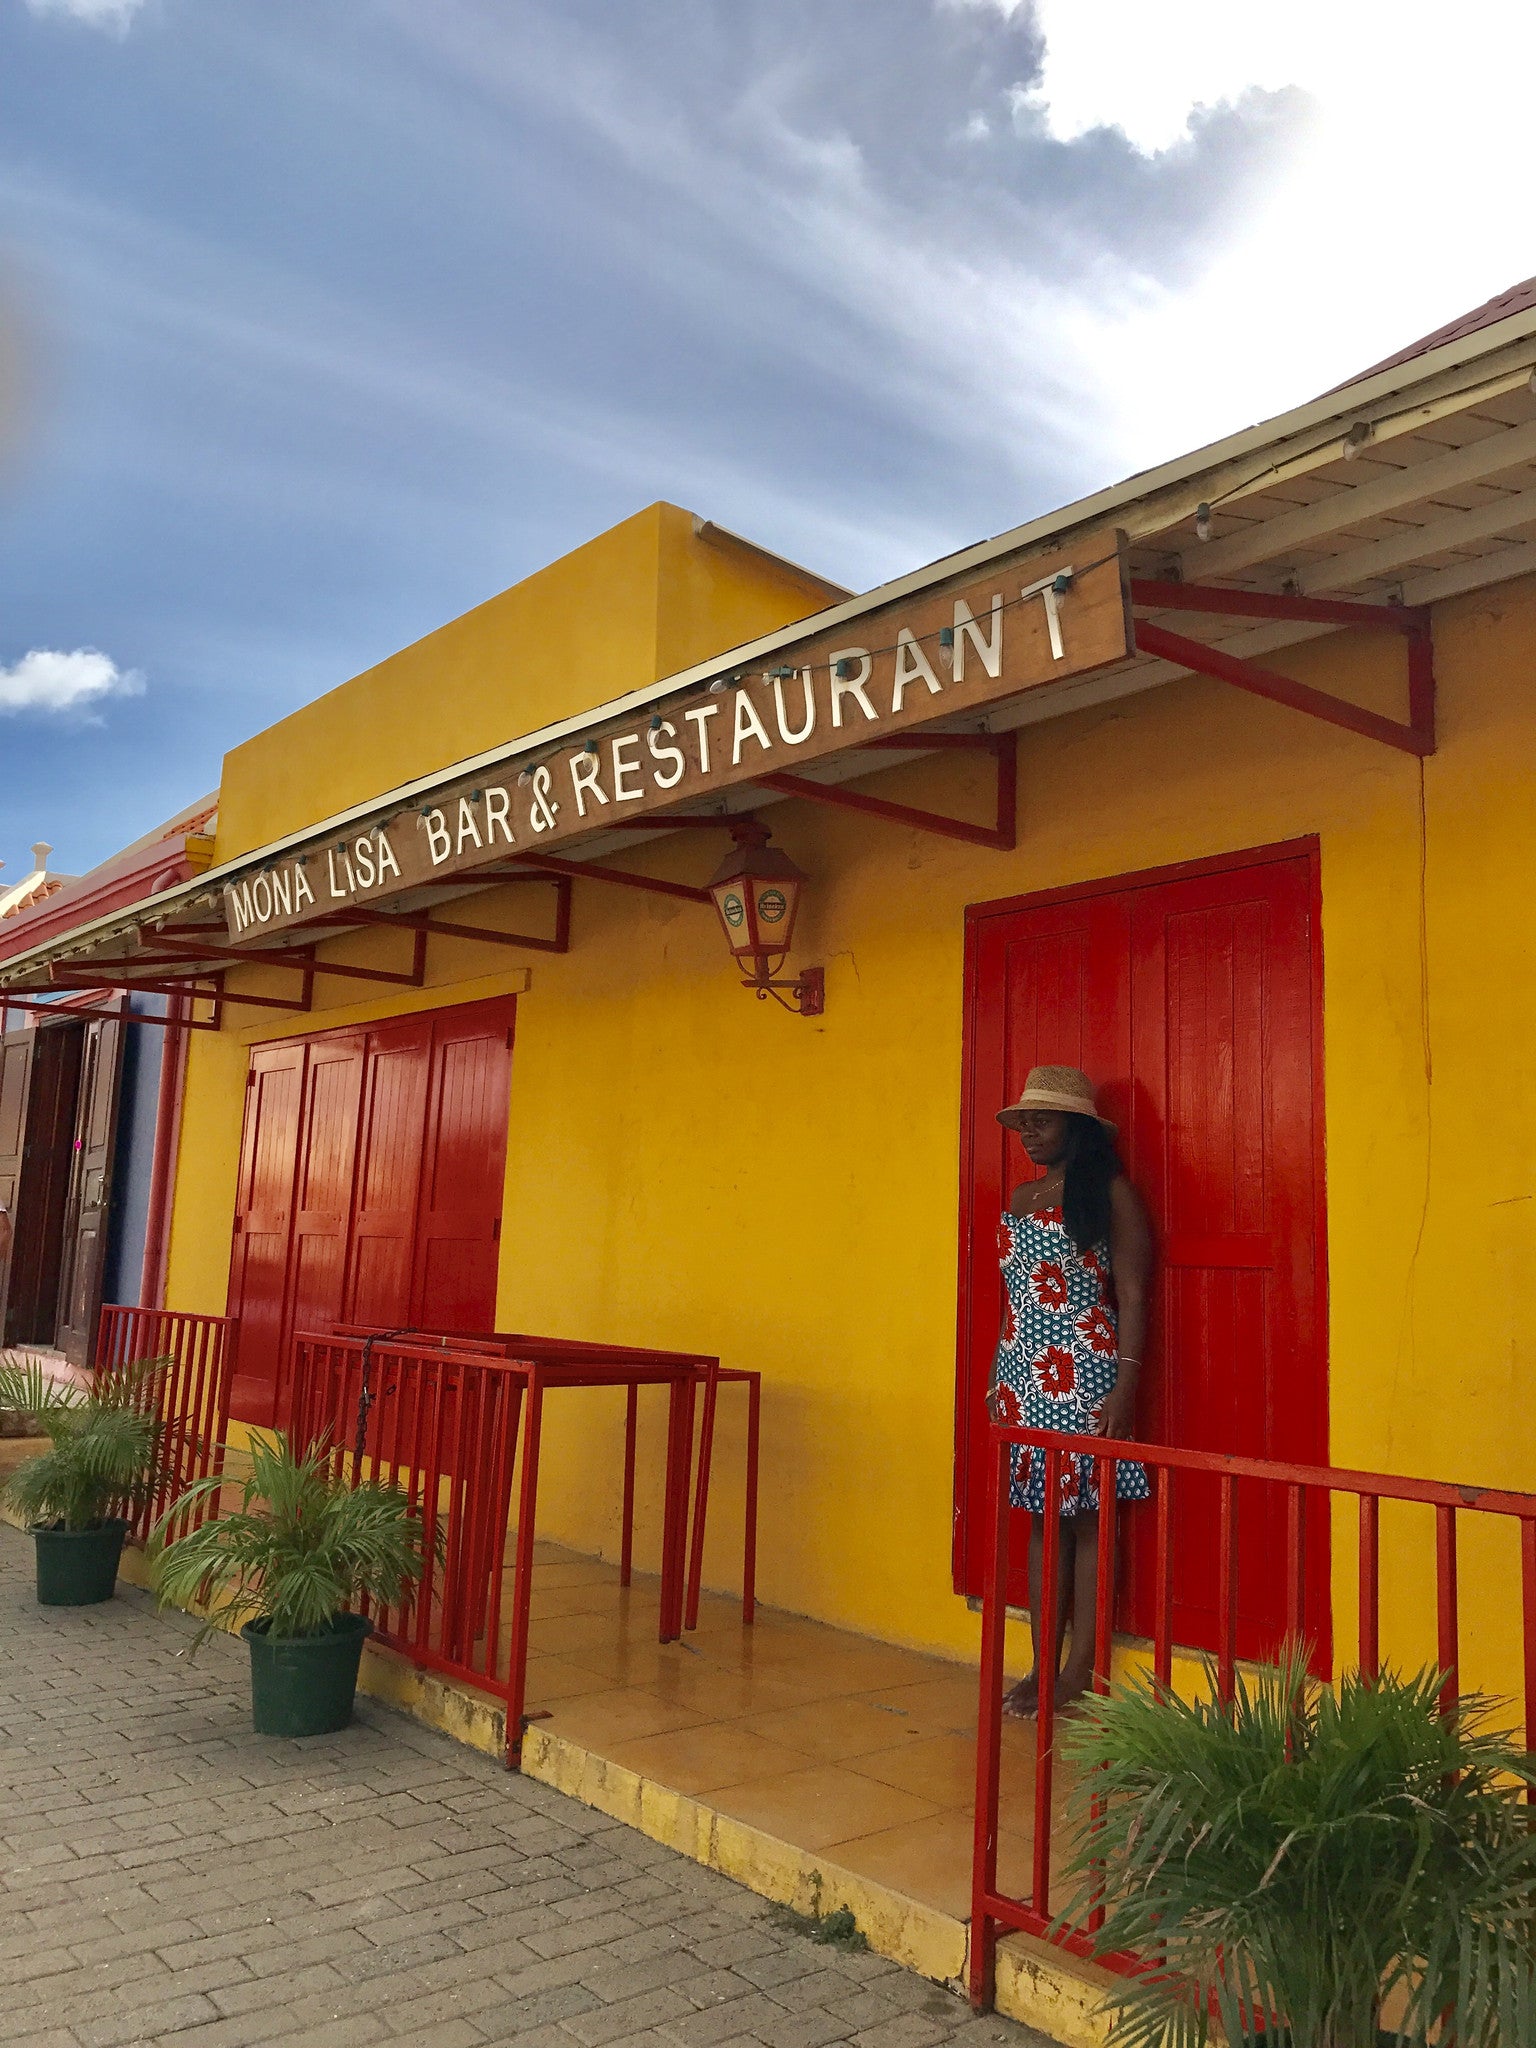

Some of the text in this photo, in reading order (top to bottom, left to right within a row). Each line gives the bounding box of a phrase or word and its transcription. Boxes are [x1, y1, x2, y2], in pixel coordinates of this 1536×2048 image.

[231, 565, 1074, 932] MONA LISA BAR & RESTAURANT
